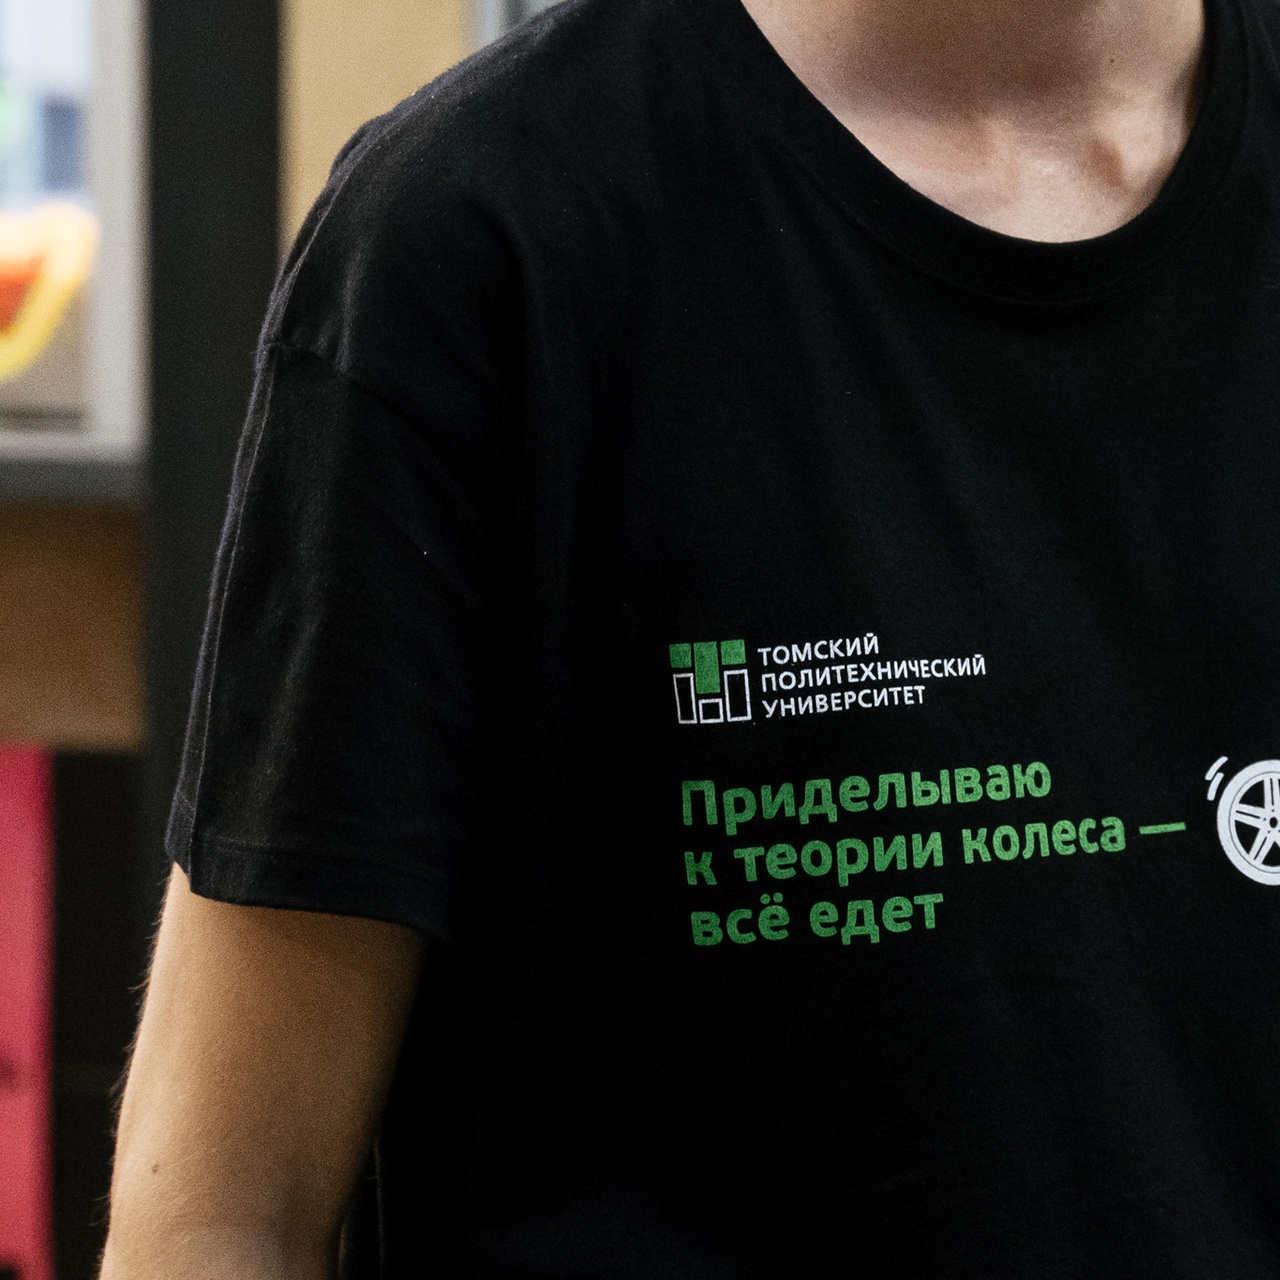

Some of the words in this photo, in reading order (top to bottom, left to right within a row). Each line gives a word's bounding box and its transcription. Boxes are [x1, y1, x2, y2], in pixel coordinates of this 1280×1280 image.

[757, 632, 880, 666] ТОМСКИЙ
[761, 654, 986, 692] ПОЛИТЕХНИЧЕСКИЙ
[762, 685, 926, 718] УНИВЕРСИТЕТ
[681, 761, 1052, 836] Приделываю
[684, 851, 717, 886] к
[733, 831, 944, 887] теории
[961, 816, 1127, 865] колеса
[690, 892, 790, 946] всё
[809, 892, 944, 945] едет
